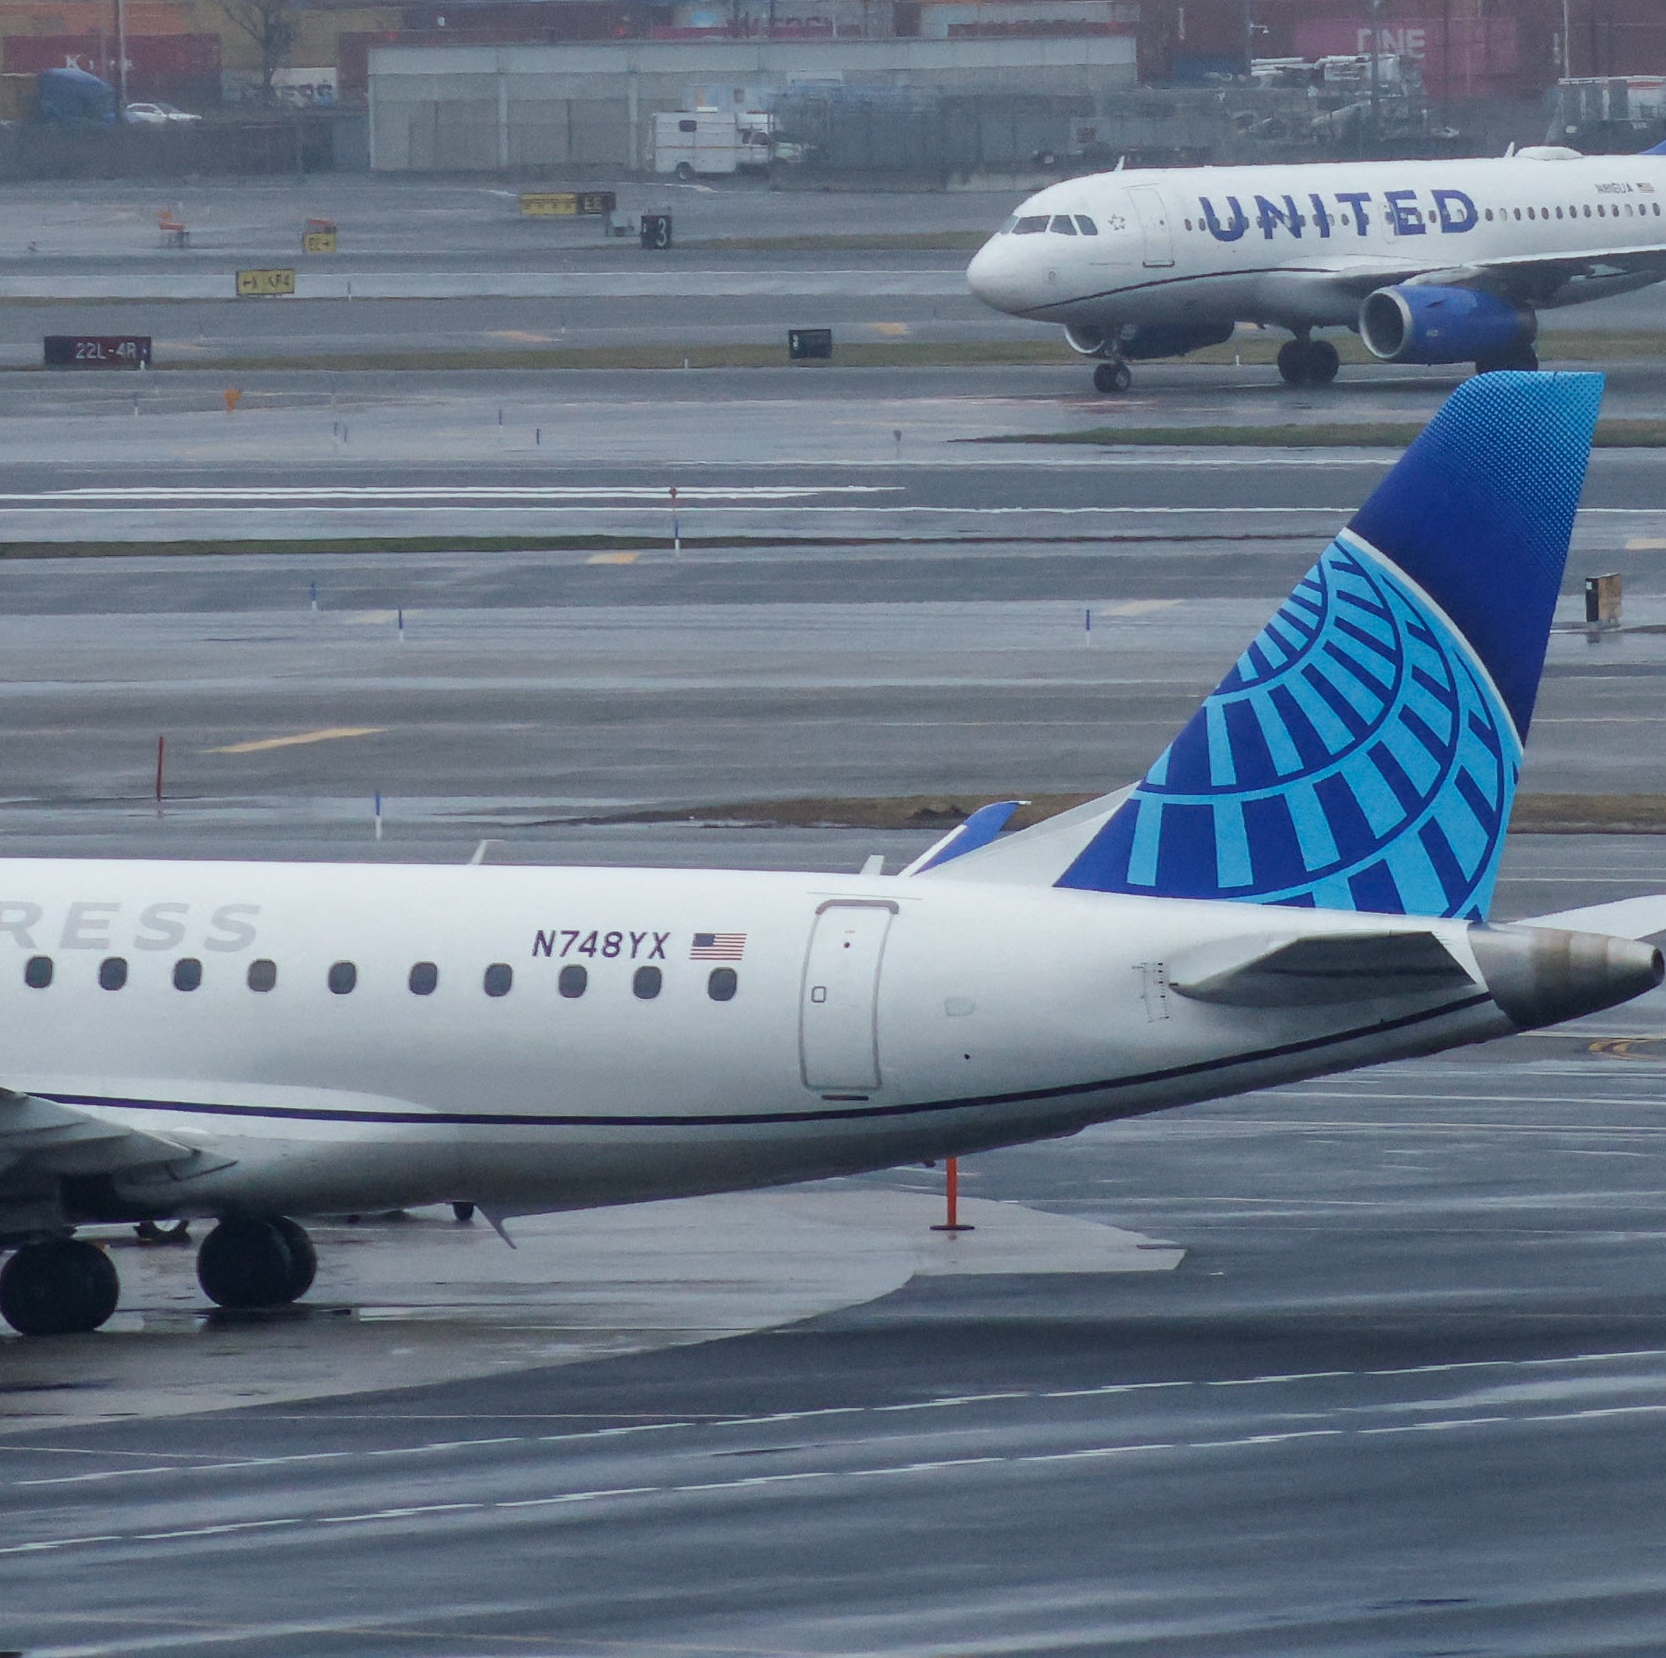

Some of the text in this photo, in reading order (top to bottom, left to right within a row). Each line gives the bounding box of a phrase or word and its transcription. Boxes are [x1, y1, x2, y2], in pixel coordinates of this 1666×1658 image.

[1197, 188, 1480, 243] UNITED
[656, 217, 668, 247] 3
[75, 342, 137, 360] 22L-4R
[531, 930, 671, 960] N748YX
